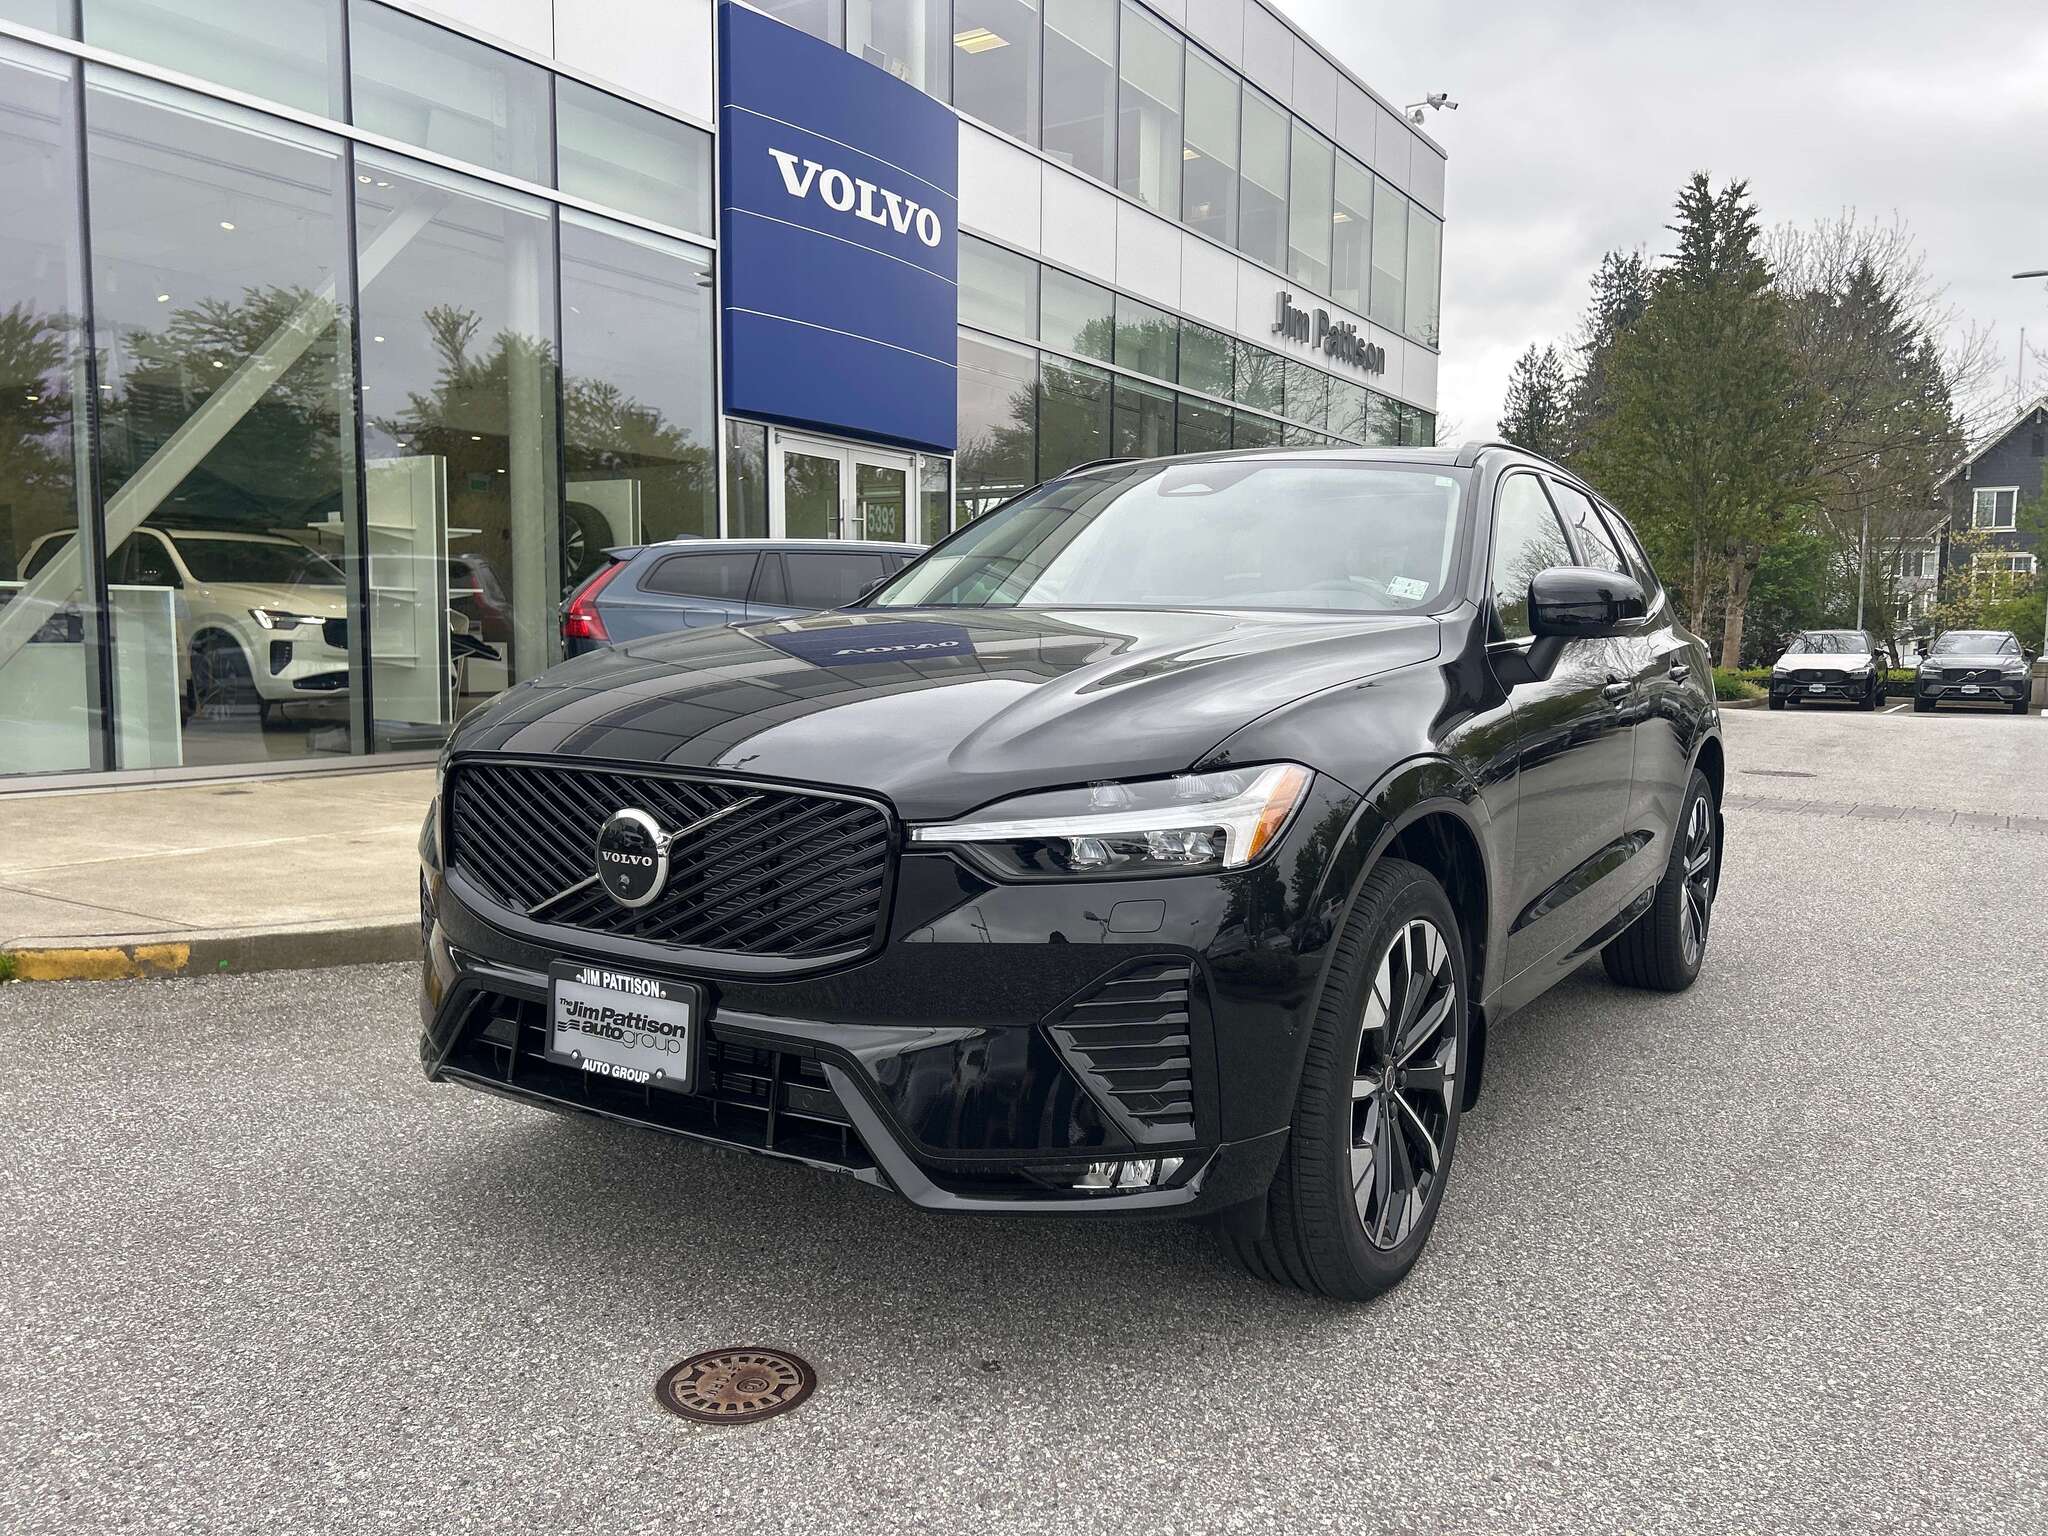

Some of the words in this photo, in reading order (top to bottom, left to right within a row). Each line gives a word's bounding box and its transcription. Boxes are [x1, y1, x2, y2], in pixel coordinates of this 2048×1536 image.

[768, 148, 941, 247] VOLVO
[1272, 291, 1309, 344] Jim
[1312, 308, 1385, 375] Pattison
[868, 505, 895, 534] 5393
[602, 851, 653, 867] VOLVO
[581, 968, 600, 987] JIM
[602, 972, 660, 998] PATTISON
[581, 1058, 610, 1076] AUTO
[611, 1065, 650, 1084] GROUP
